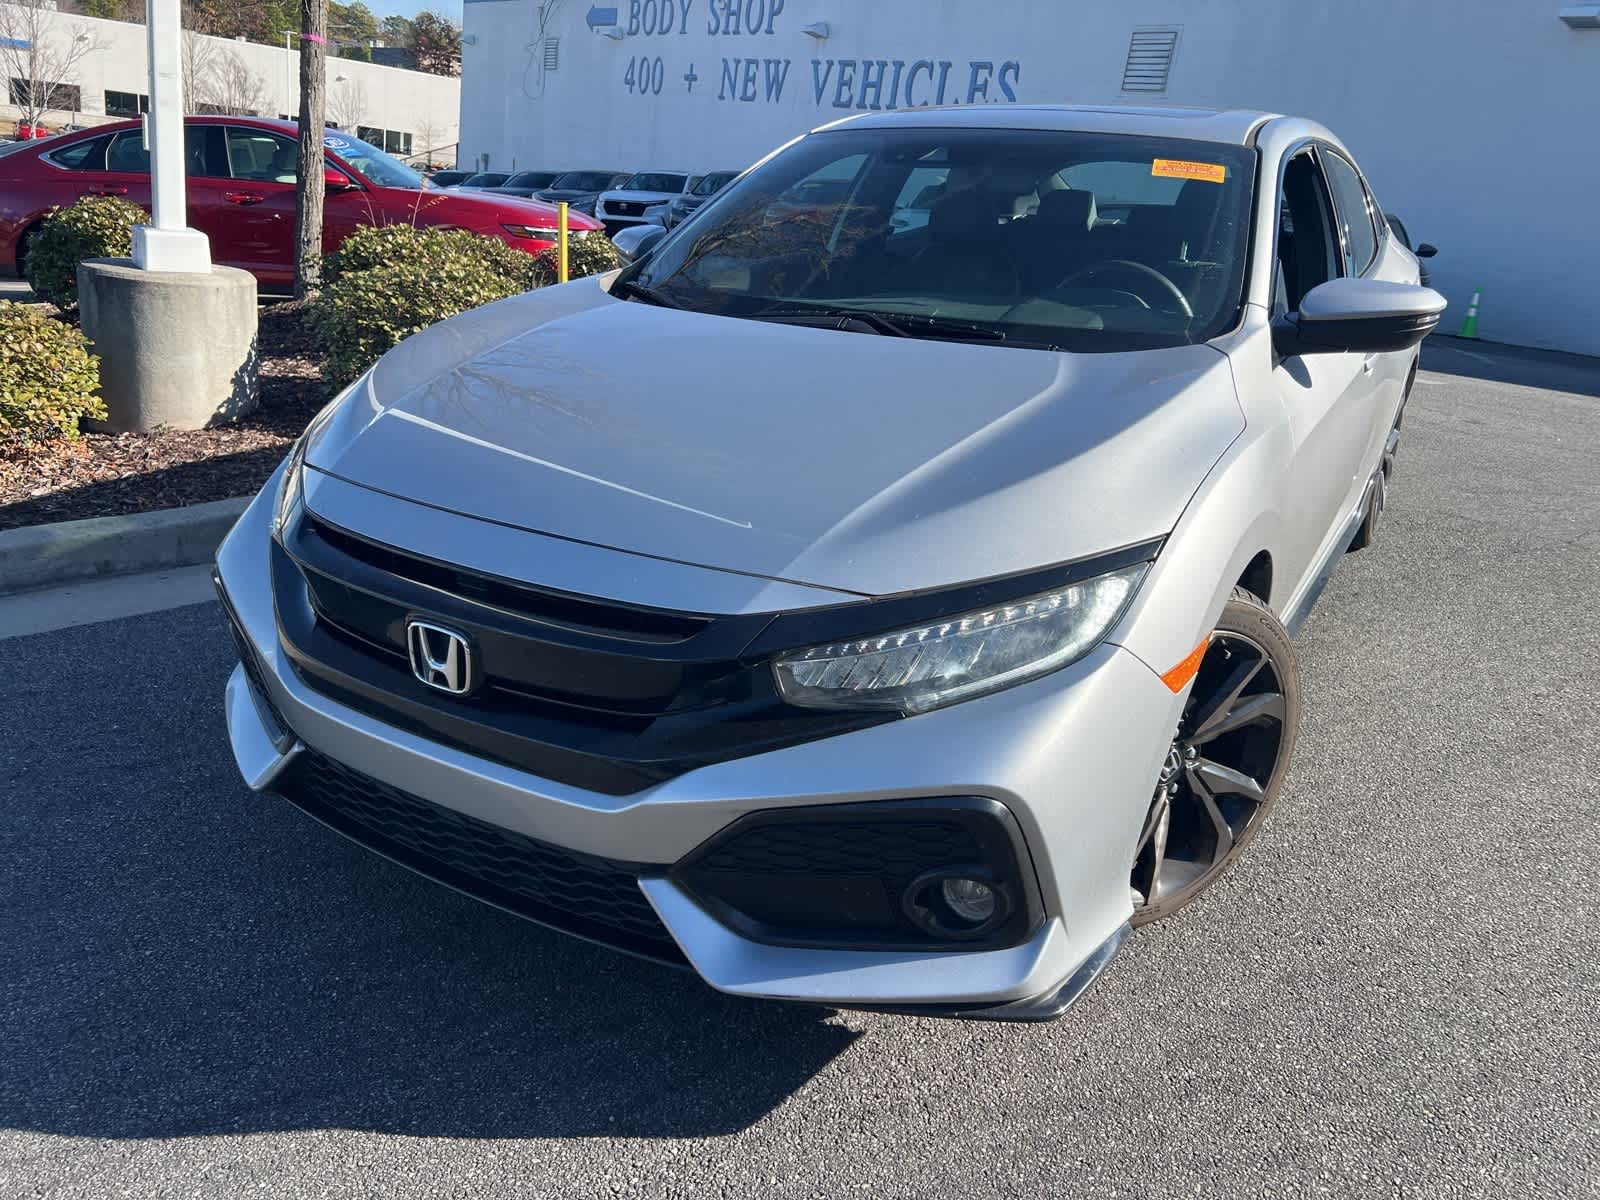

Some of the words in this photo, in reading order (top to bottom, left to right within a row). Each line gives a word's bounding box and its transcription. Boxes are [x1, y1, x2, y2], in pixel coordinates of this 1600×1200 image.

[627, 0, 692, 36] BODY
[707, 0, 785, 36] SHOP
[624, 56, 664, 96] 400
[683, 63, 698, 93] +
[717, 57, 791, 104] NEW
[811, 59, 1020, 110] VEHICLES
